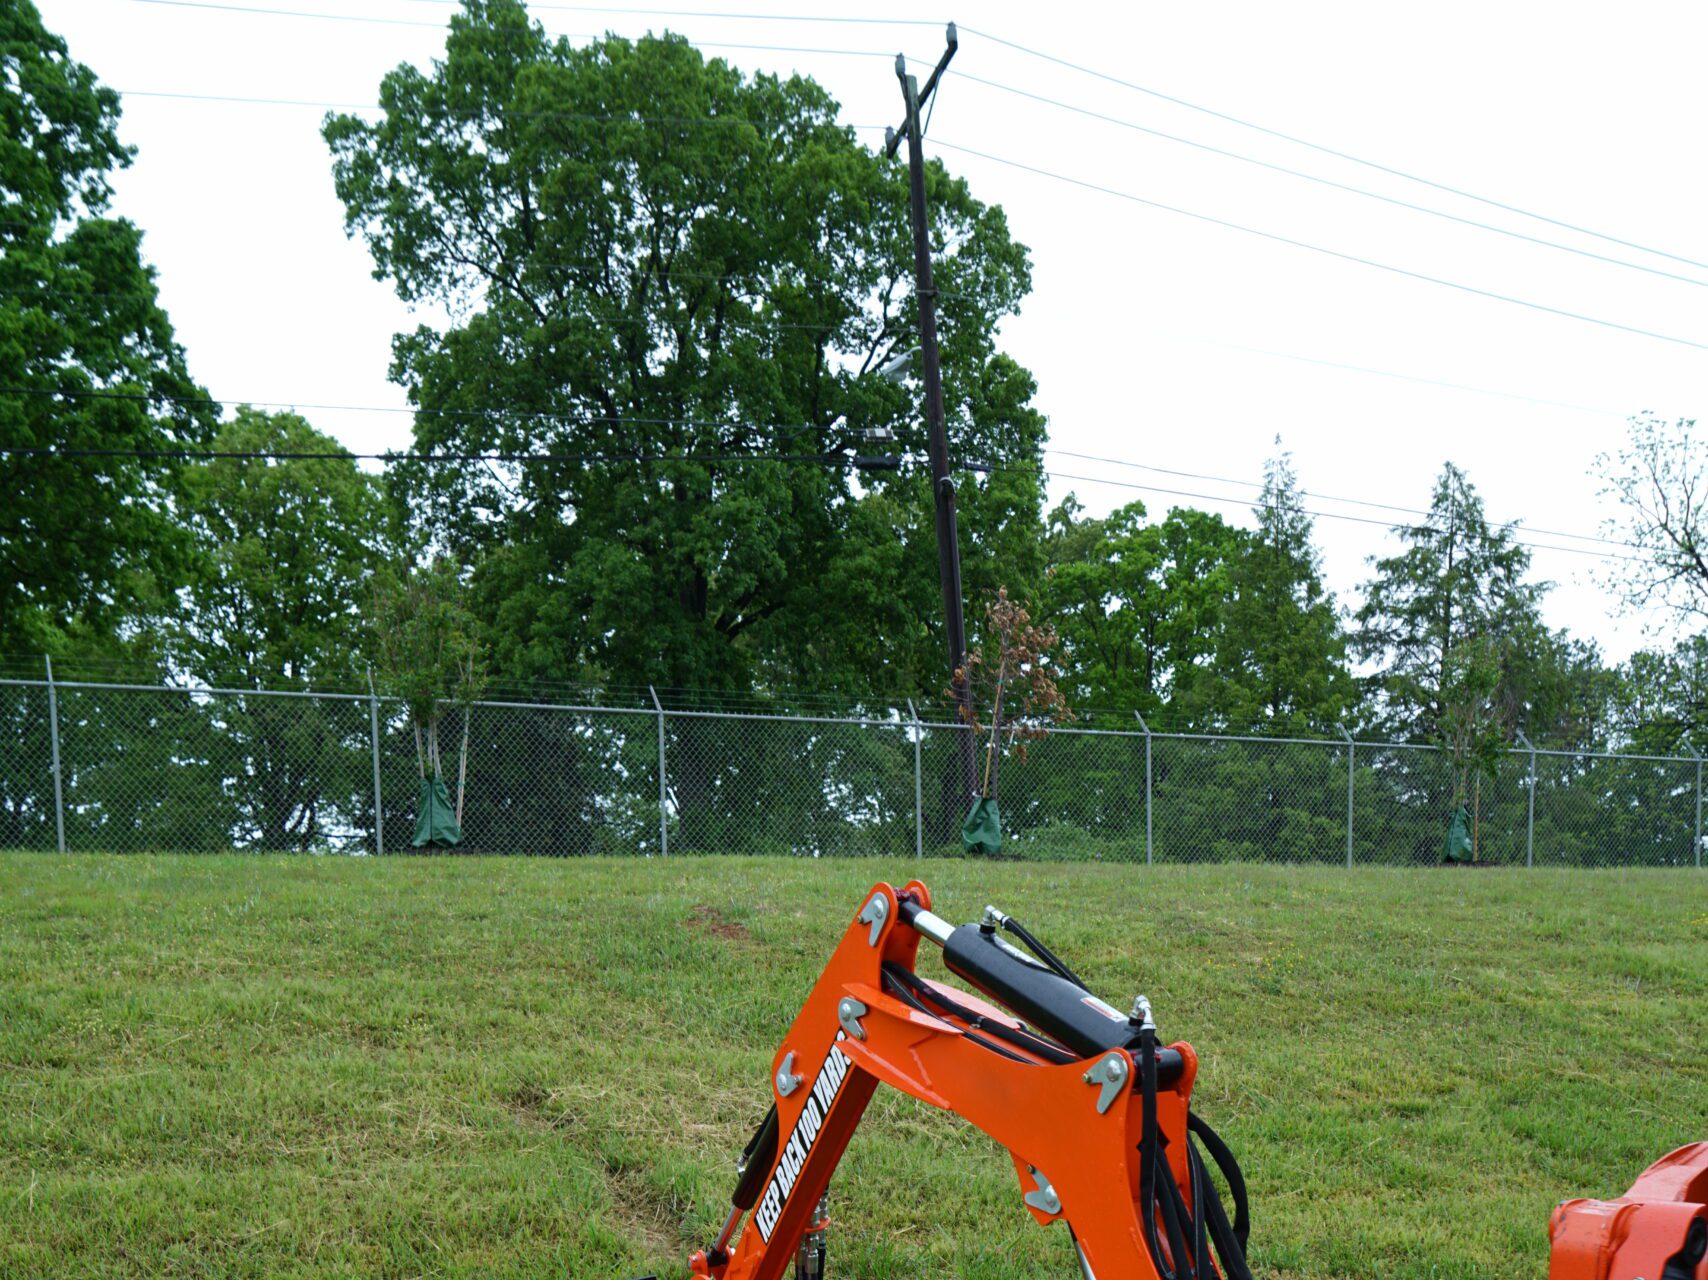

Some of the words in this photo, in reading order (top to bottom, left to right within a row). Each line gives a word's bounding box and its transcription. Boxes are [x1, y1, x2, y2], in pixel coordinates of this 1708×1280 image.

[754, 1179, 782, 1244] KEEP
[775, 1127, 808, 1200] BACK
[798, 1096, 822, 1151] 100
